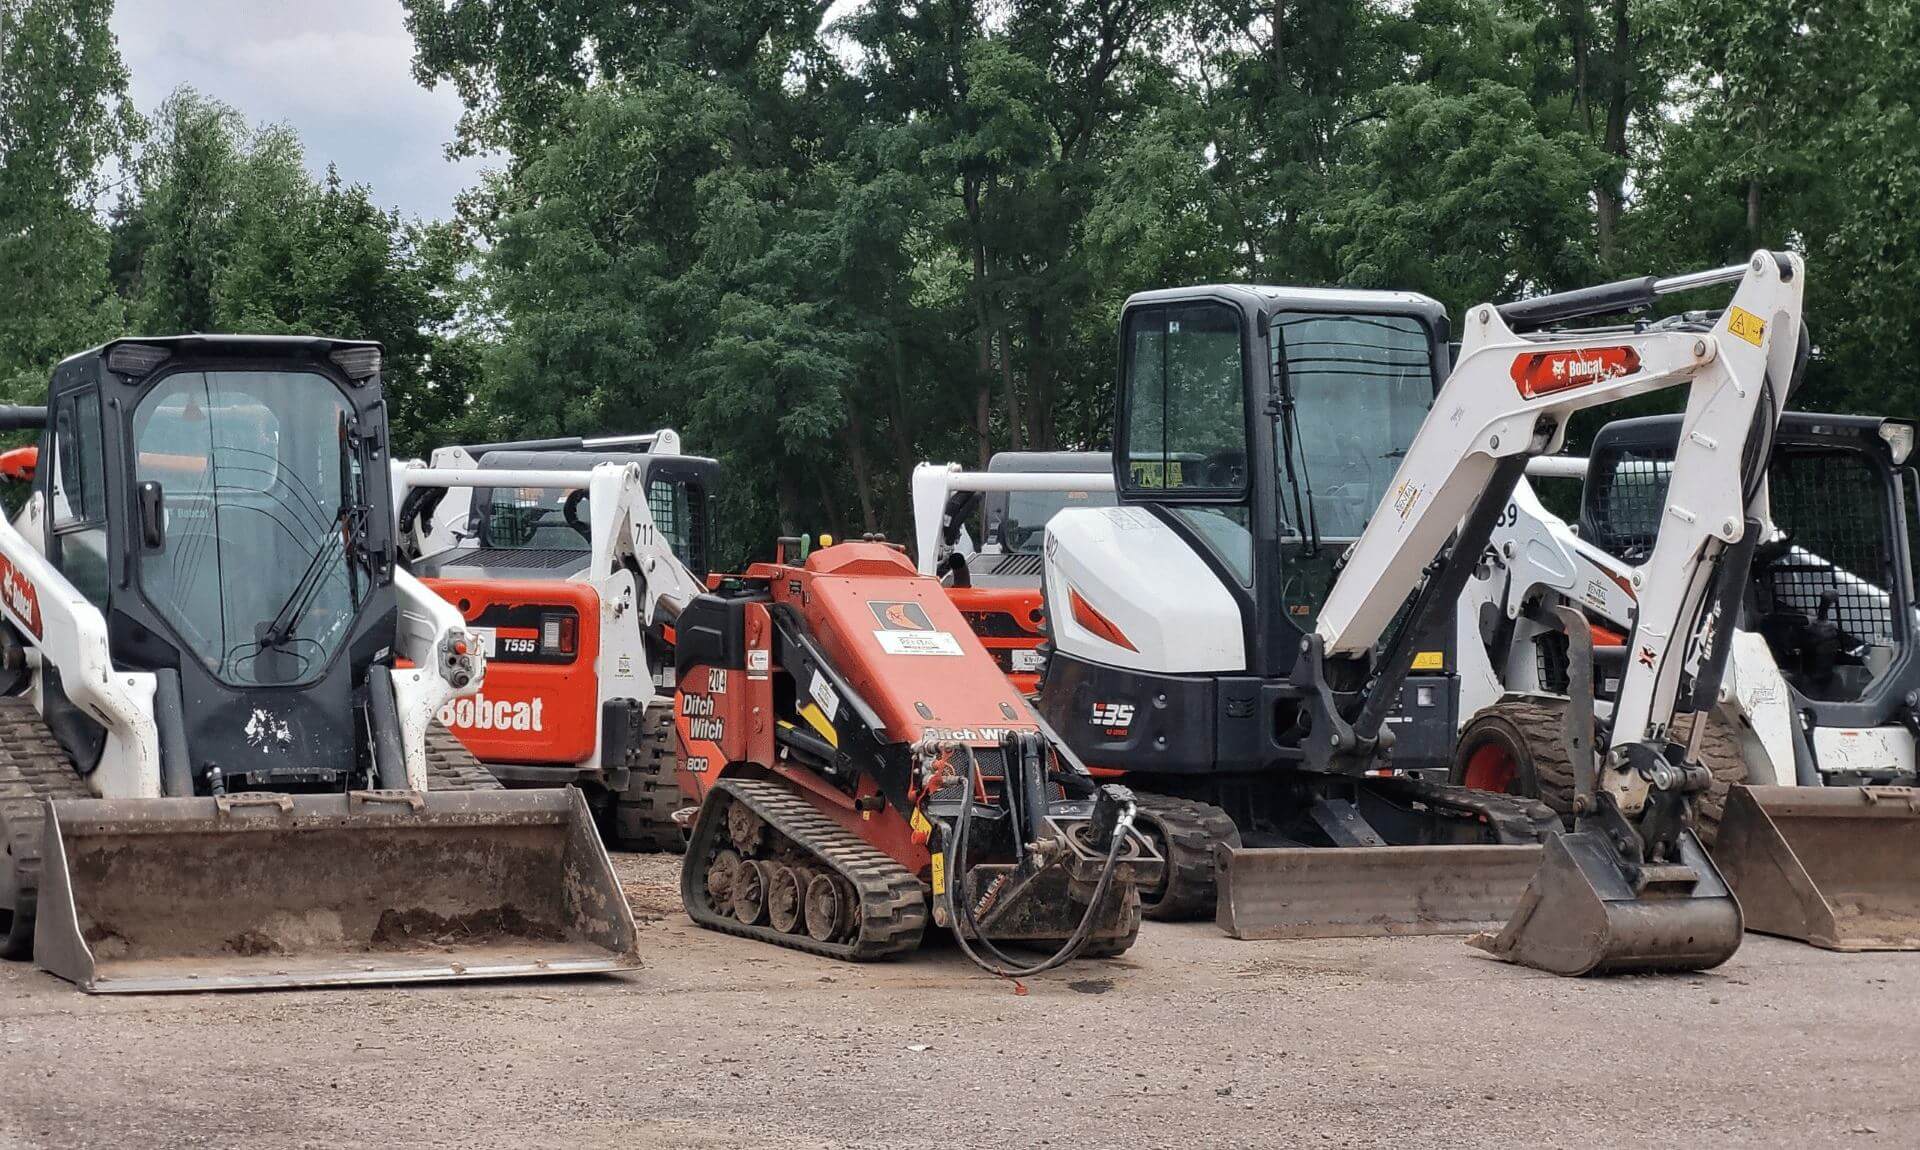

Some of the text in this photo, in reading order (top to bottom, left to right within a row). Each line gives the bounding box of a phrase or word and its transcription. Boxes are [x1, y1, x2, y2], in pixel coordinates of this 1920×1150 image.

[1569, 357, 1603, 377] Bobcat
[635, 523, 653, 546] 711
[504, 639, 536, 653] T595
[708, 669, 726, 692] 204
[436, 693, 543, 732] Bobcat
[683, 694, 714, 716] Ditch
[690, 718, 724, 740] Witch
[923, 727, 977, 740] Ditch
